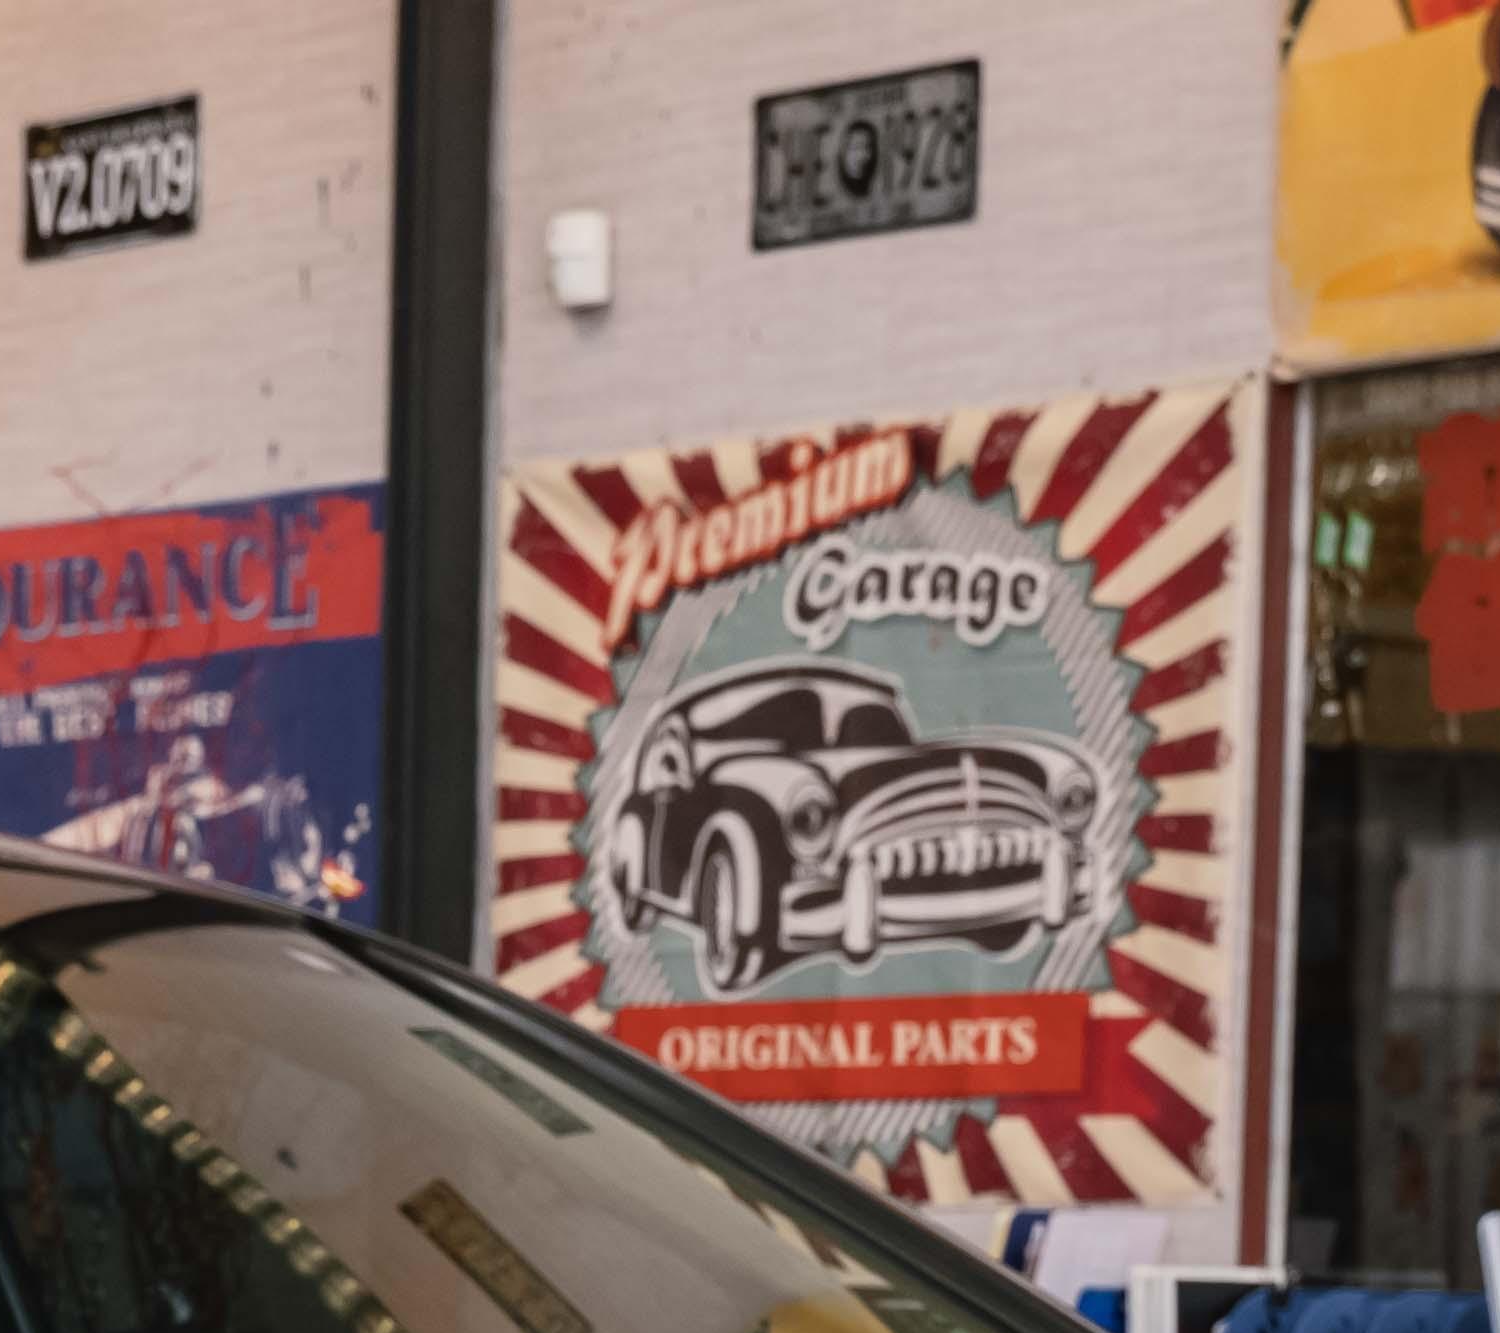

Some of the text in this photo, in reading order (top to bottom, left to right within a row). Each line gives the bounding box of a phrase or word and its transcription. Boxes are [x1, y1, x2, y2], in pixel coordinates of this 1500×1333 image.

[602, 427, 914, 654] Premium
[789, 542, 1044, 646] Garage
[658, 1018, 1038, 1073] ORIGINAL PARTS
